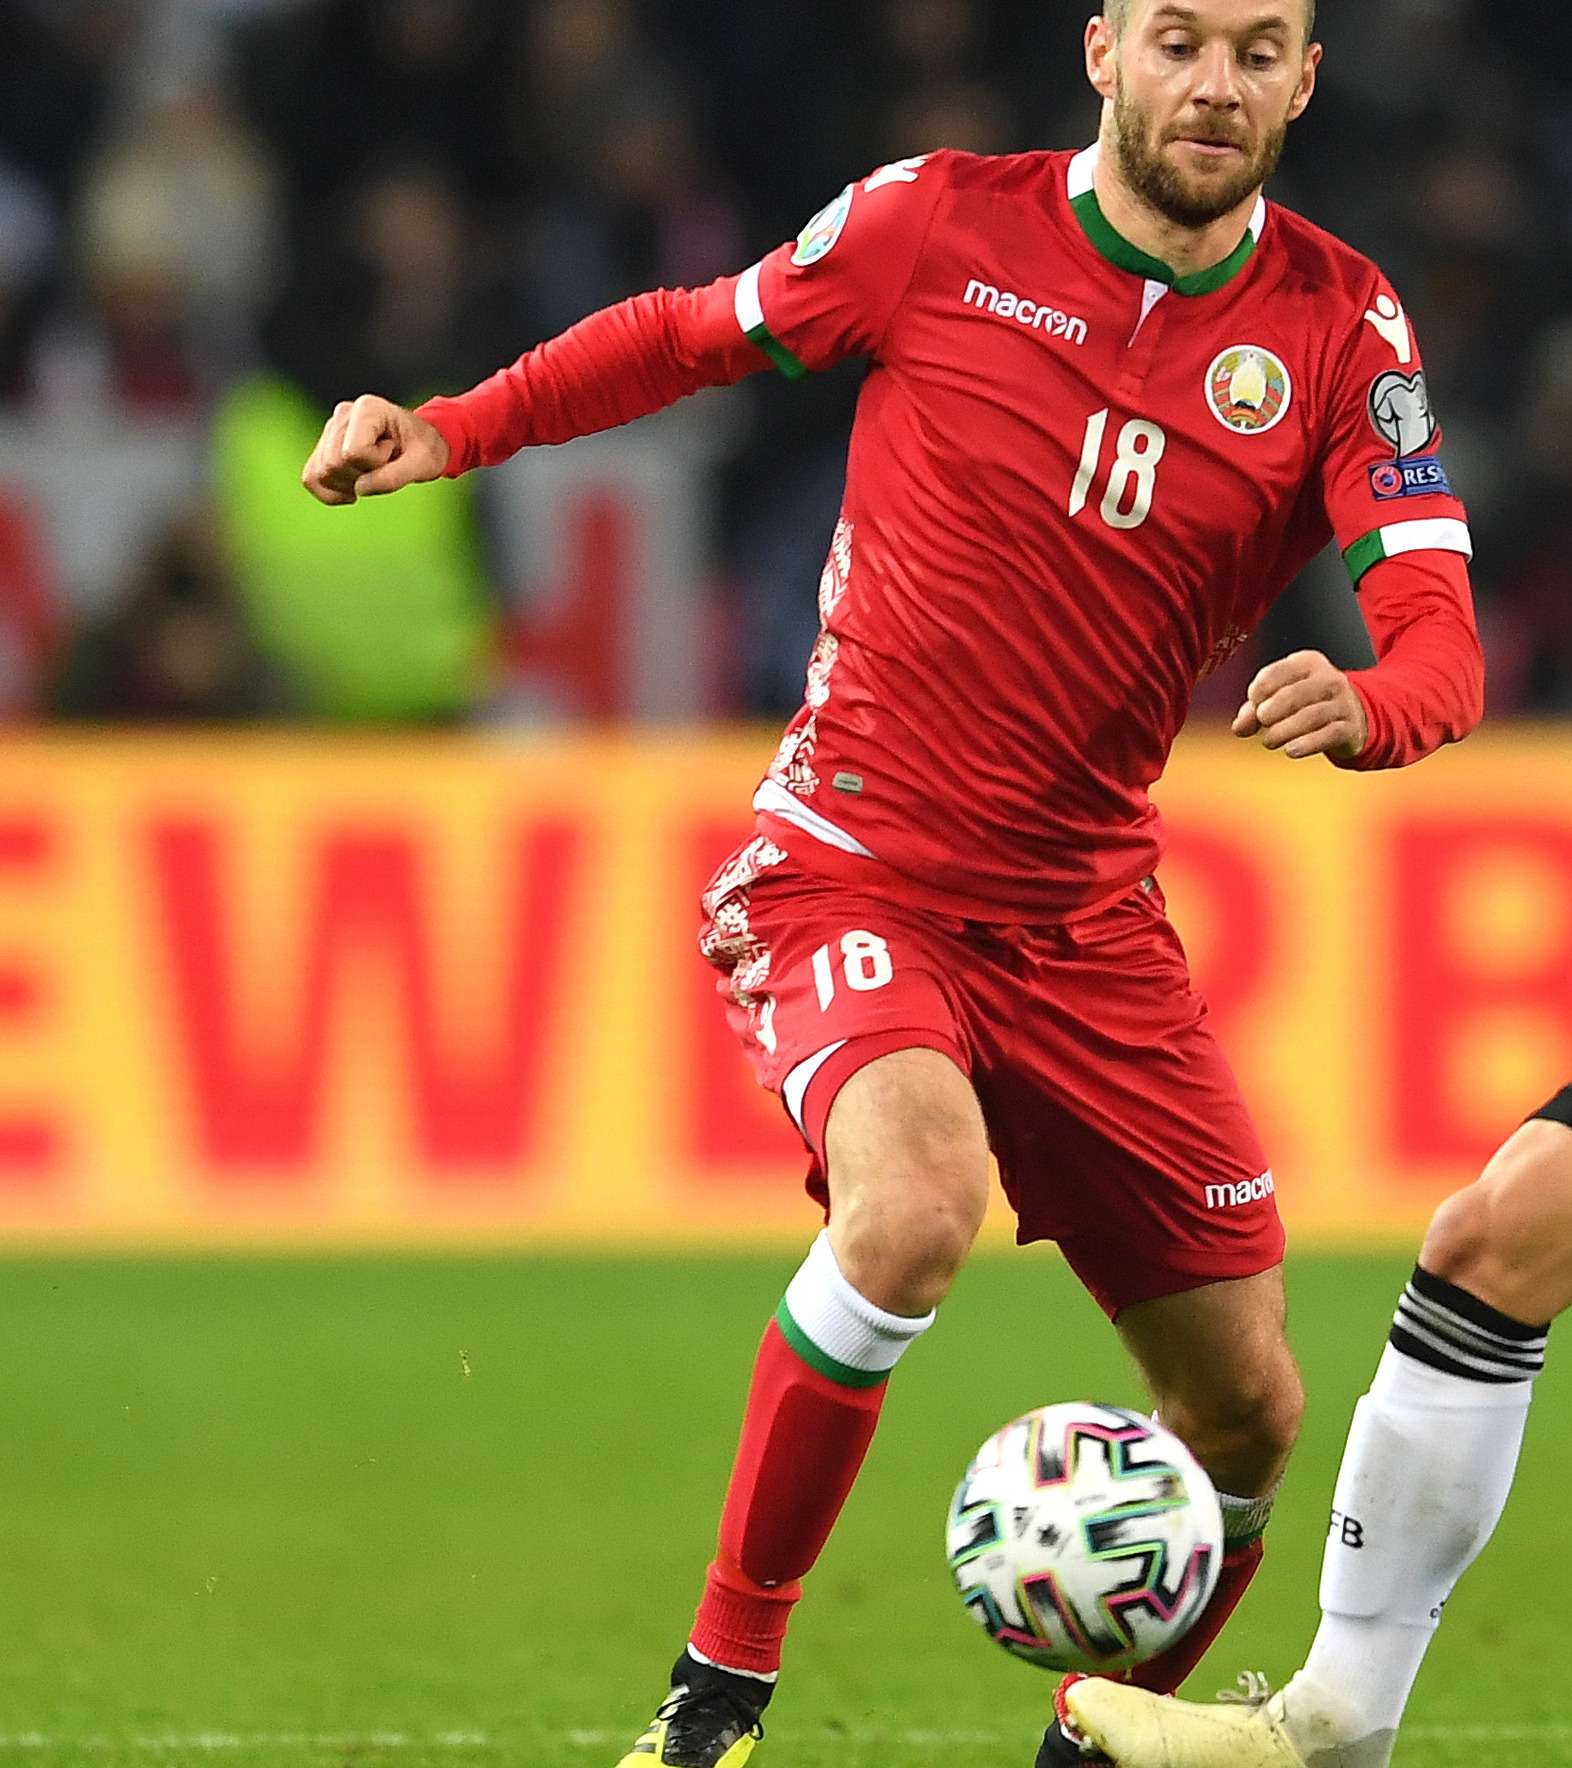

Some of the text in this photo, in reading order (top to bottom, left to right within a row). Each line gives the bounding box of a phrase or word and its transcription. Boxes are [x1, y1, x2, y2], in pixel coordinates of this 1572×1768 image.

[962, 278, 1088, 346] macron
[1068, 407, 1166, 529] 18
[811, 928, 894, 1013] 18
